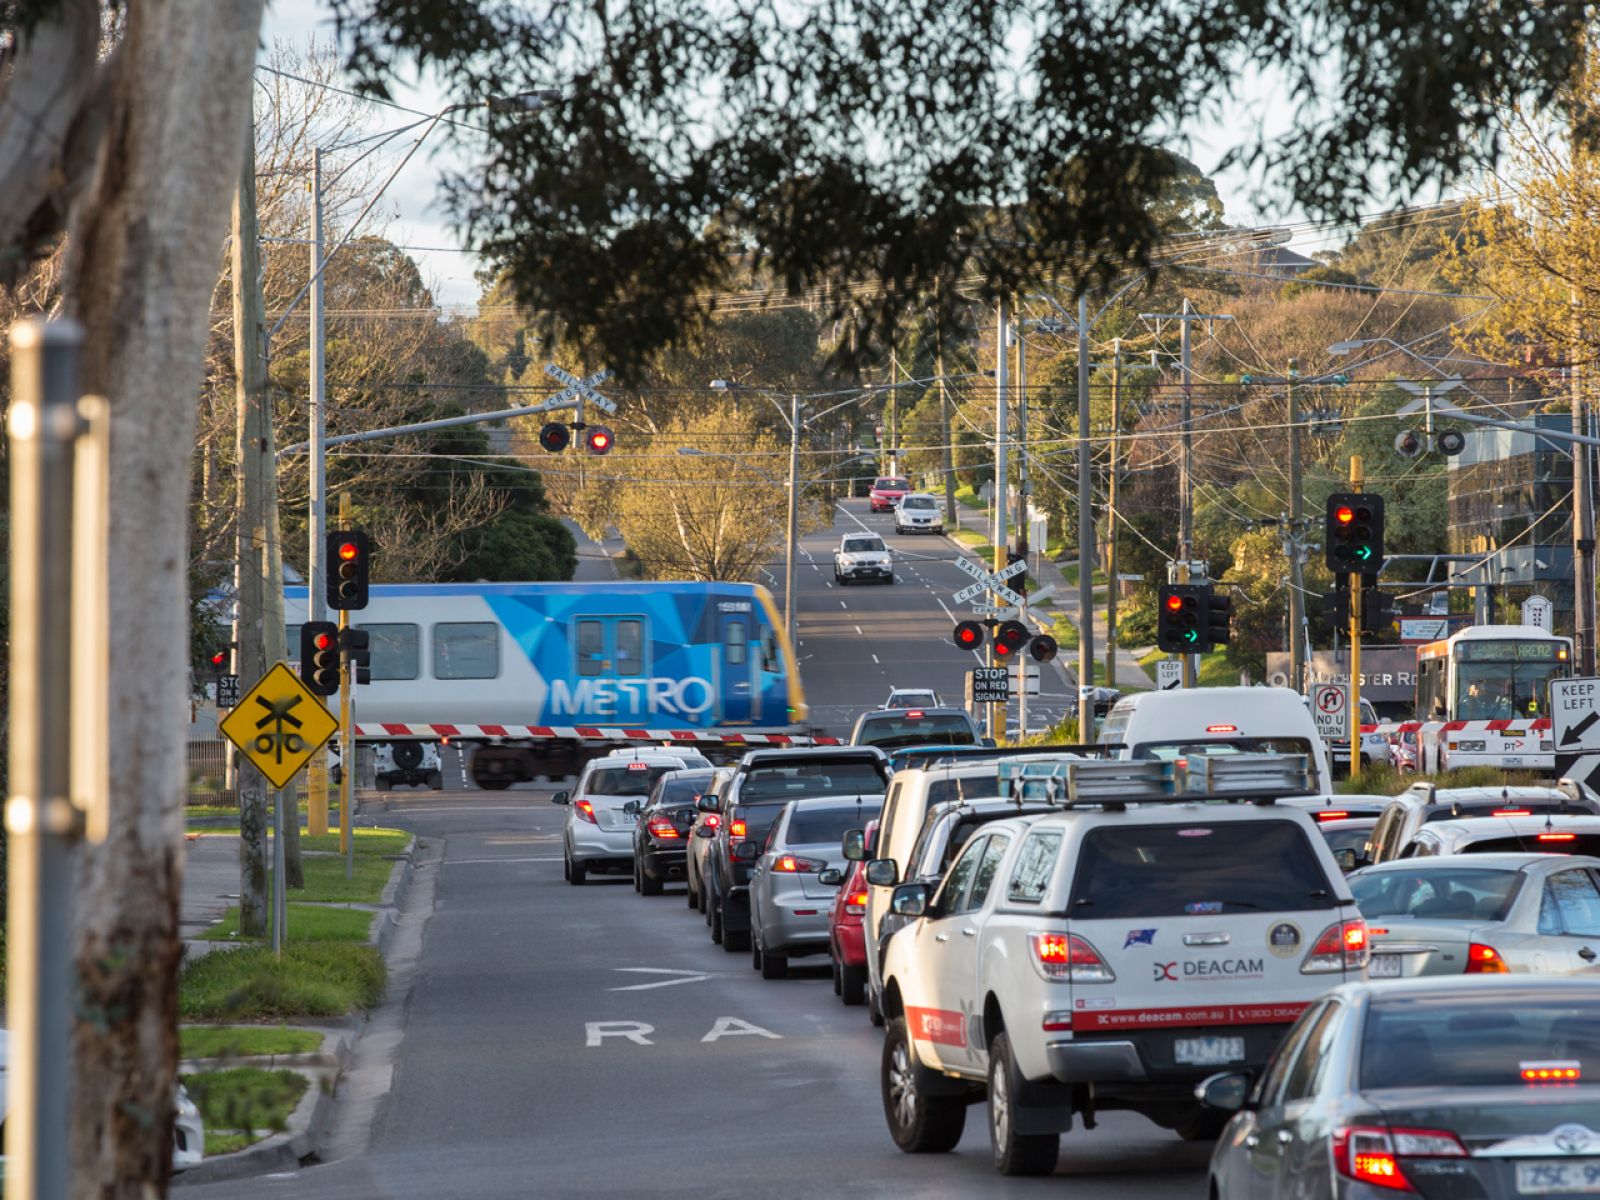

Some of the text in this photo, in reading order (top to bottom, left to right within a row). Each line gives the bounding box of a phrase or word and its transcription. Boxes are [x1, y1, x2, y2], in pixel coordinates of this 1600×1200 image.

[959, 563, 1022, 600] CROSSING
[975, 669, 1007, 680] STOP
[974, 681, 1007, 690] ON RED
[1562, 684, 1595, 696] KEEP
[551, 676, 715, 715] METRO
[975, 692, 1008, 701] SIGNAL
[1564, 698, 1594, 710] LEFT
[1317, 715, 1344, 724] NO U
[1318, 726, 1342, 735] TURN
[1183, 958, 1264, 976] DEACAM
[1110, 1010, 1224, 1024] www.deacam.com.au
[1273, 1007, 1306, 1017] DEAC
